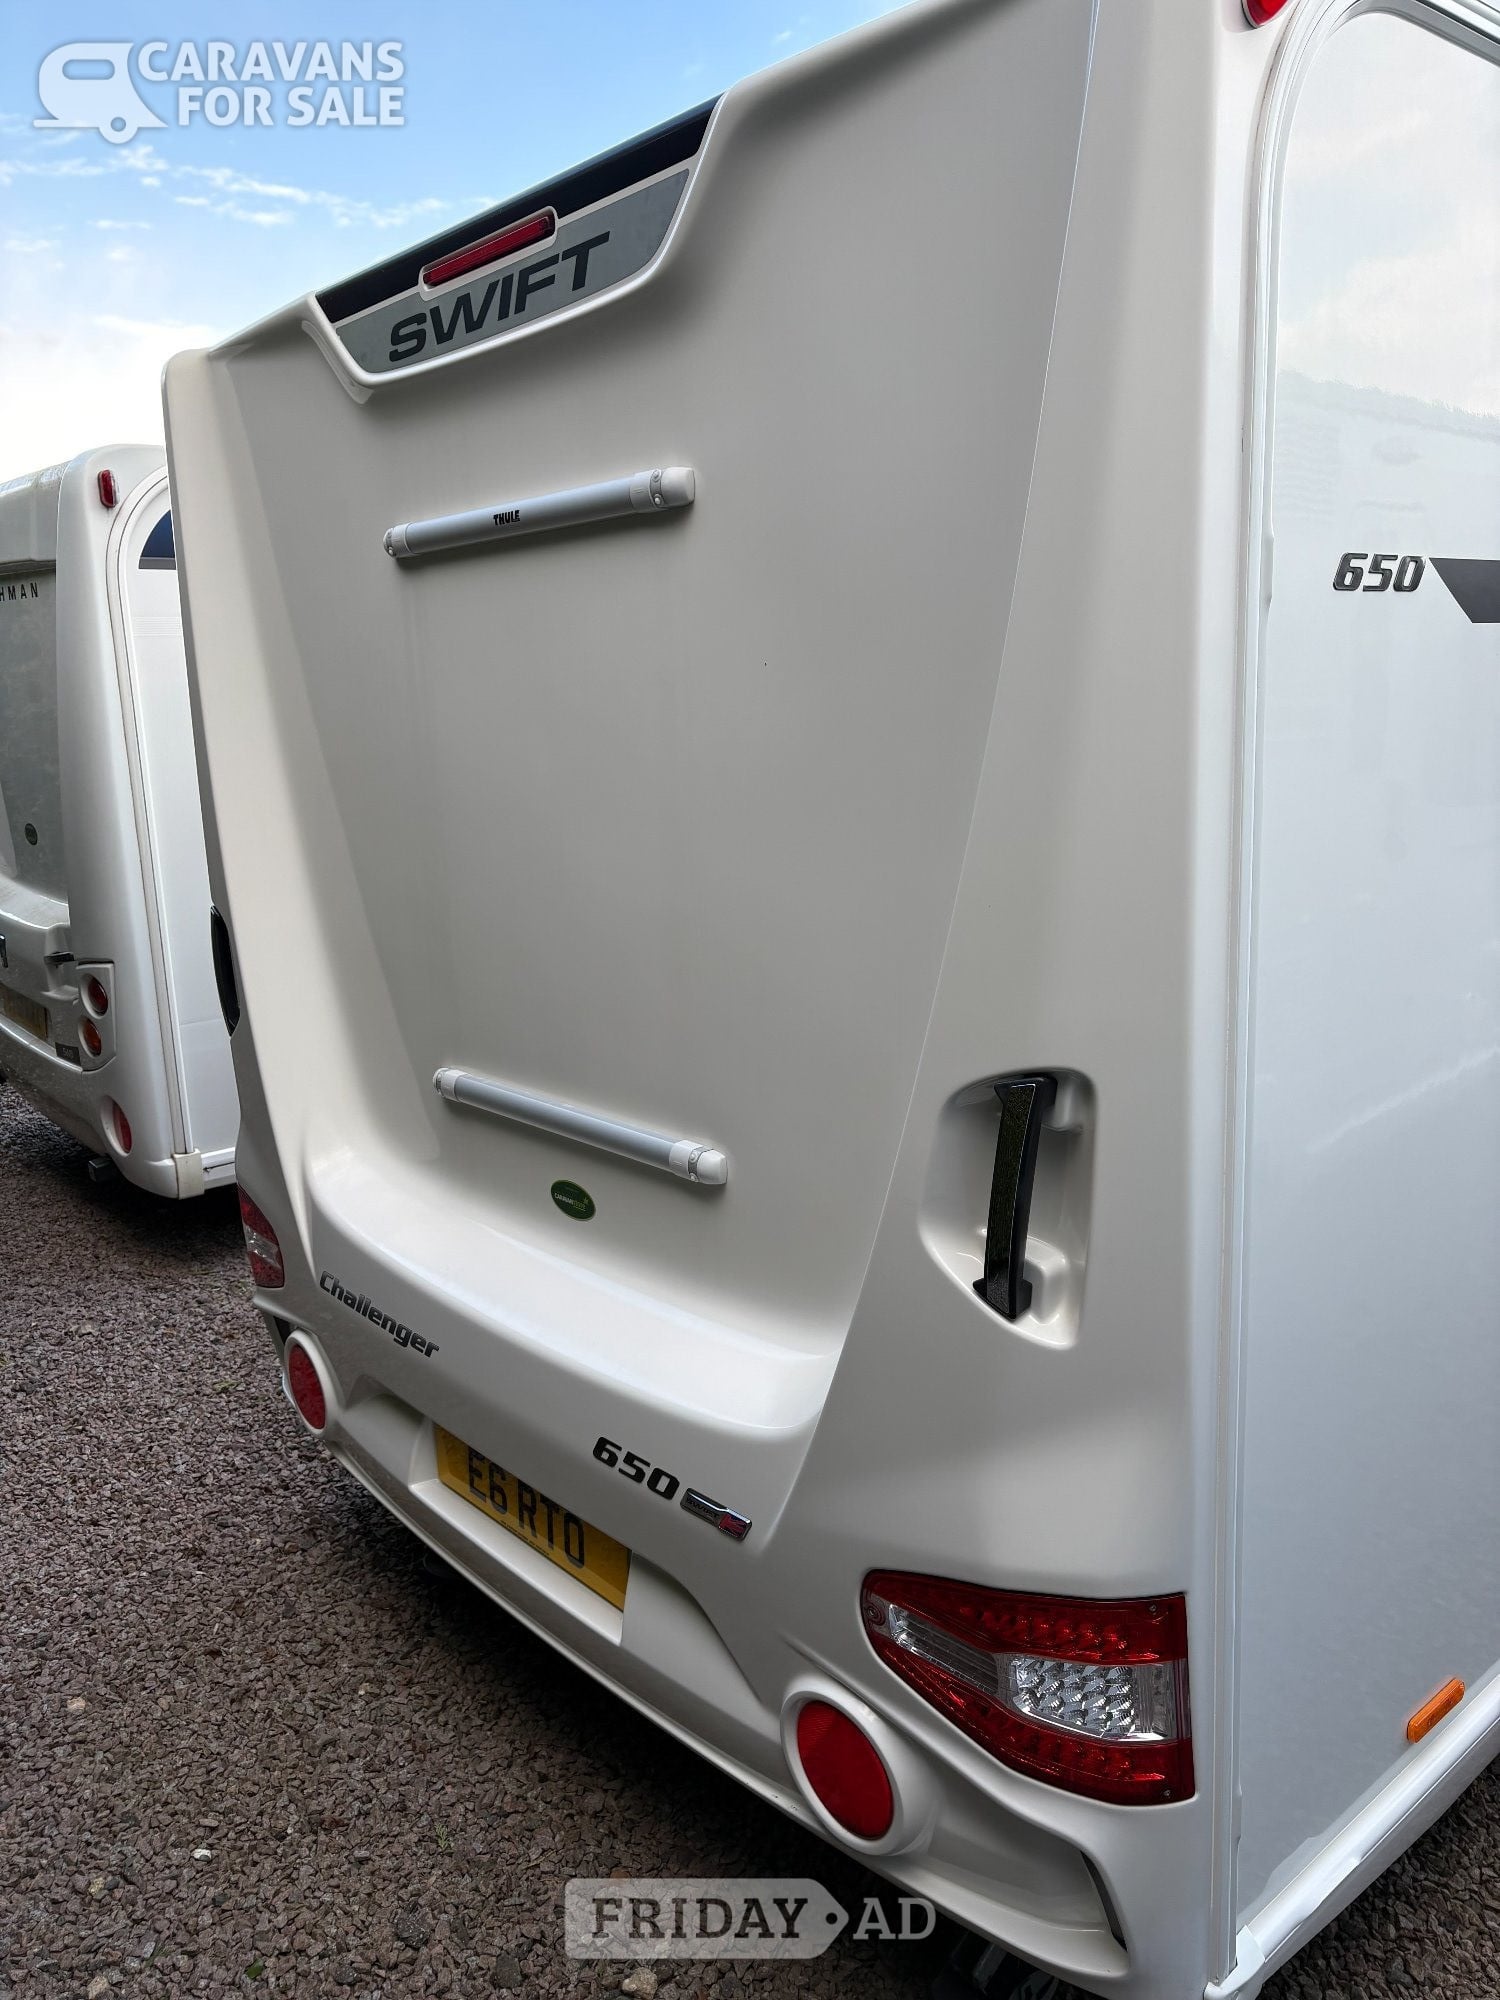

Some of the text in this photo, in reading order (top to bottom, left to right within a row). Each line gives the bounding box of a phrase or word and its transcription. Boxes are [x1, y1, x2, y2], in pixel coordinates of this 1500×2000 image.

[389, 230, 610, 362] SWIFT
[493, 510, 520, 526] THULE
[1333, 552, 1426, 592] 650
[320, 1271, 440, 1358] Challenger
[592, 1436, 680, 1500] 650
[468, 1447, 508, 1515] E6
[517, 1479, 585, 1569] RTO
